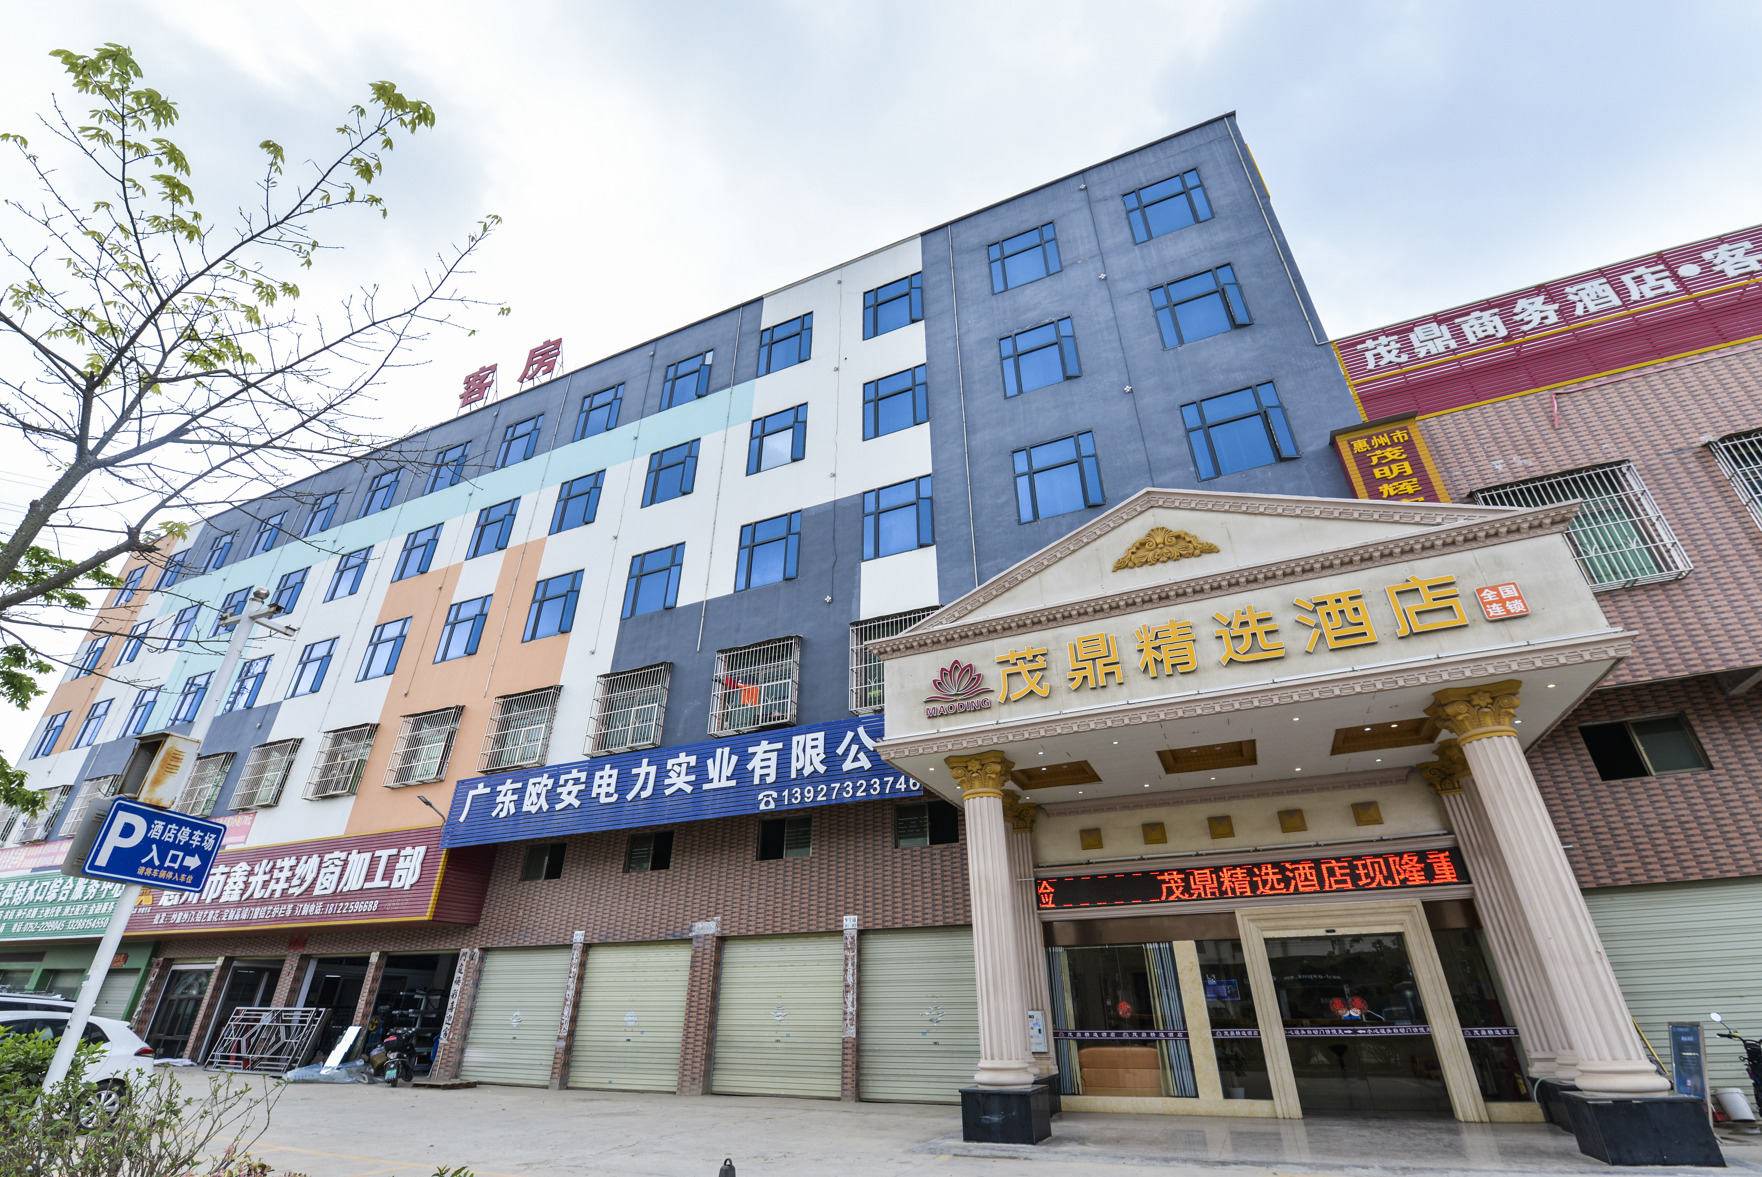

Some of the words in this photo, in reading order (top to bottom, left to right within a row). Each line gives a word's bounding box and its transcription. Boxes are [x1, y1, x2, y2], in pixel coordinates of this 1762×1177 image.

[459, 338, 562, 408] 客房
[1350, 430, 1409, 454] 惠州市
[1366, 446, 1425, 502] 茂明辉
[1479, 583, 1518, 602] 全国
[1485, 599, 1529, 618] 连锁
[995, 575, 1470, 705] 茂鼎精选酒店
[925, 697, 992, 718] MAODING
[458, 725, 875, 823] 广东欧安电力实业有限公
[94, 810, 147, 867] P
[148, 820, 217, 851] 酒店停车场
[141, 844, 184, 870] 入口
[137, 866, 194, 884] 请将车辆停入车位
[1157, 851, 1459, 901] 茂鼎精选酒店现隆重
